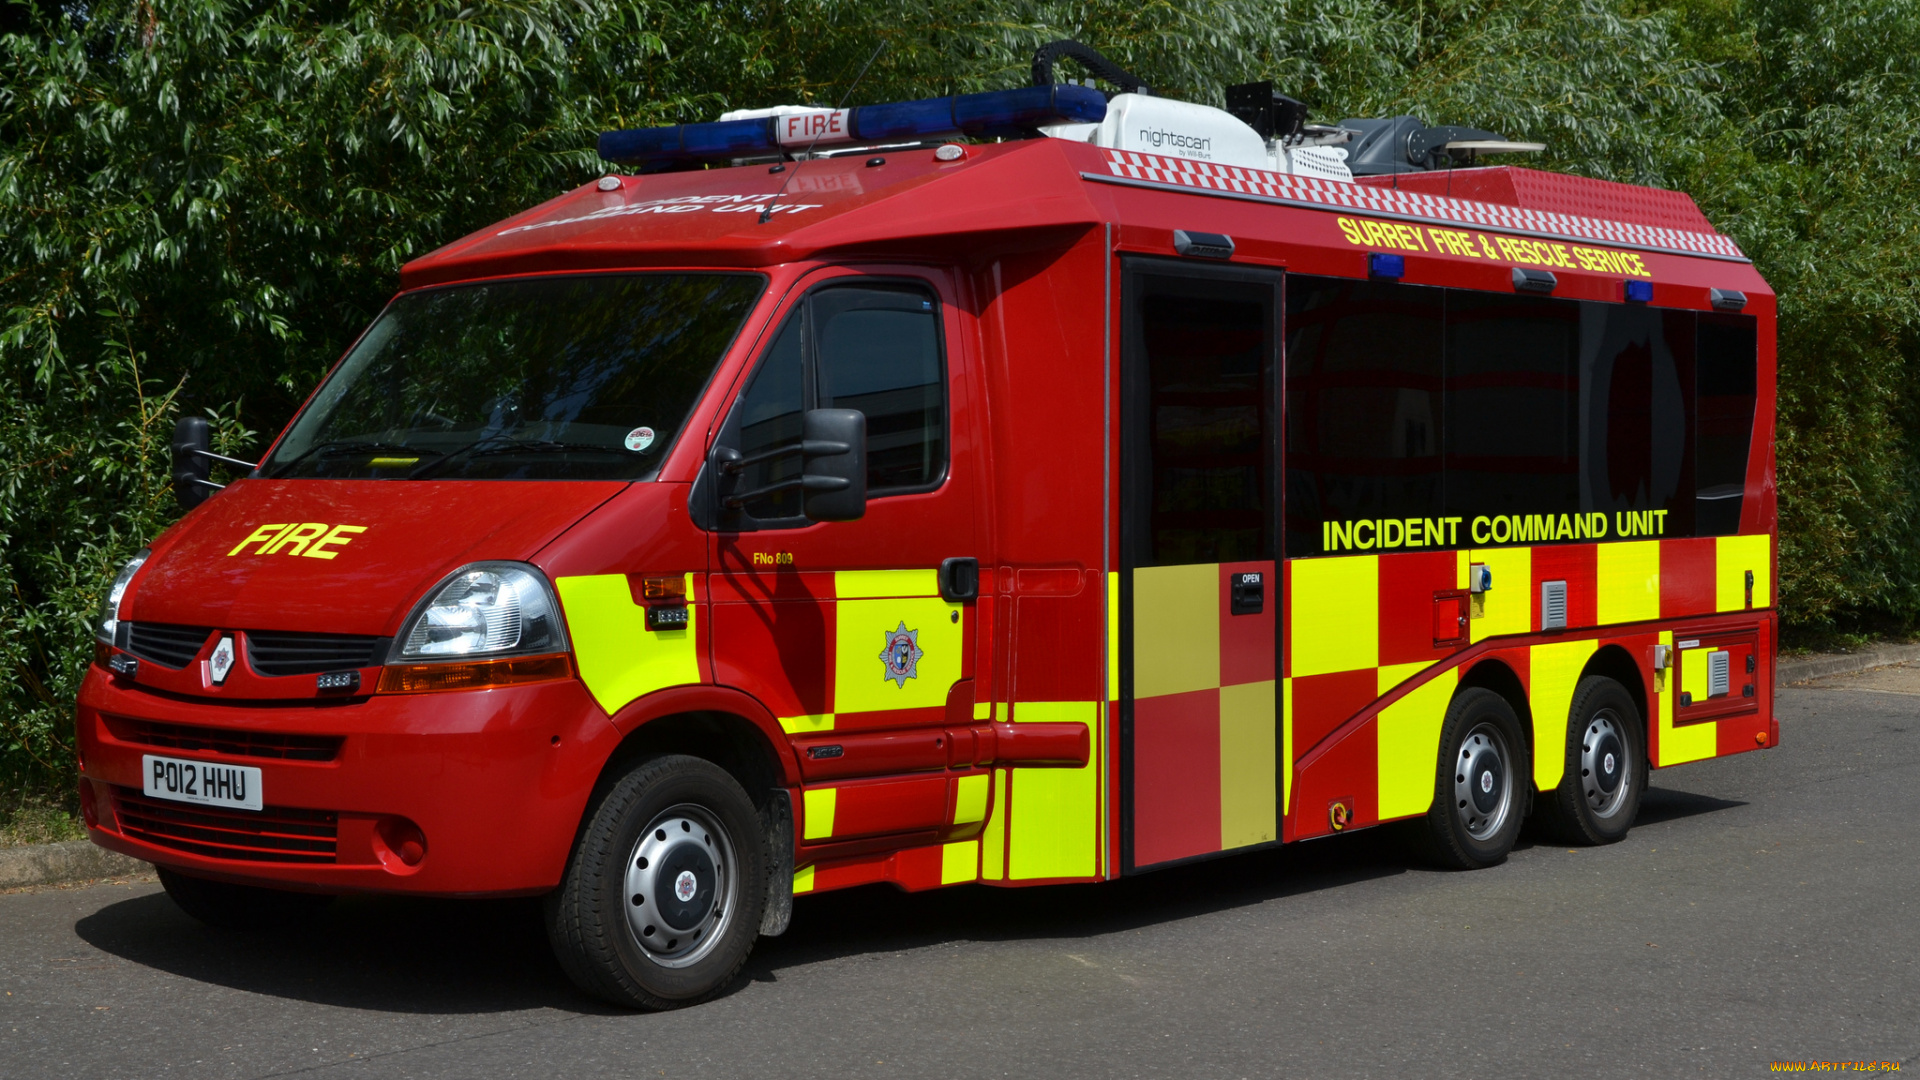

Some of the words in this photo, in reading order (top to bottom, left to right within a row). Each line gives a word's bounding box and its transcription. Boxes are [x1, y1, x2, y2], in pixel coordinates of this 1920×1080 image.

[788, 112, 842, 138] FIRE
[1139, 126, 1211, 151] nightscan
[712, 204, 824, 214] UNIT
[1337, 216, 1429, 252] SURREY
[1427, 228, 1482, 258] FIRE
[1477, 234, 1501, 261] &
[1495, 236, 1578, 269] RESCUE
[1571, 246, 1652, 278] SERVICE
[226, 522, 369, 560] FIRE
[1323, 516, 1462, 552] INCIDENT
[1471, 512, 1609, 545] COMMAND
[1616, 509, 1668, 537] UNIT
[753, 552, 774, 565] FNo
[775, 552, 793, 565] 809
[1242, 573, 1260, 583] OPEN
[203, 766, 246, 802] HHU
